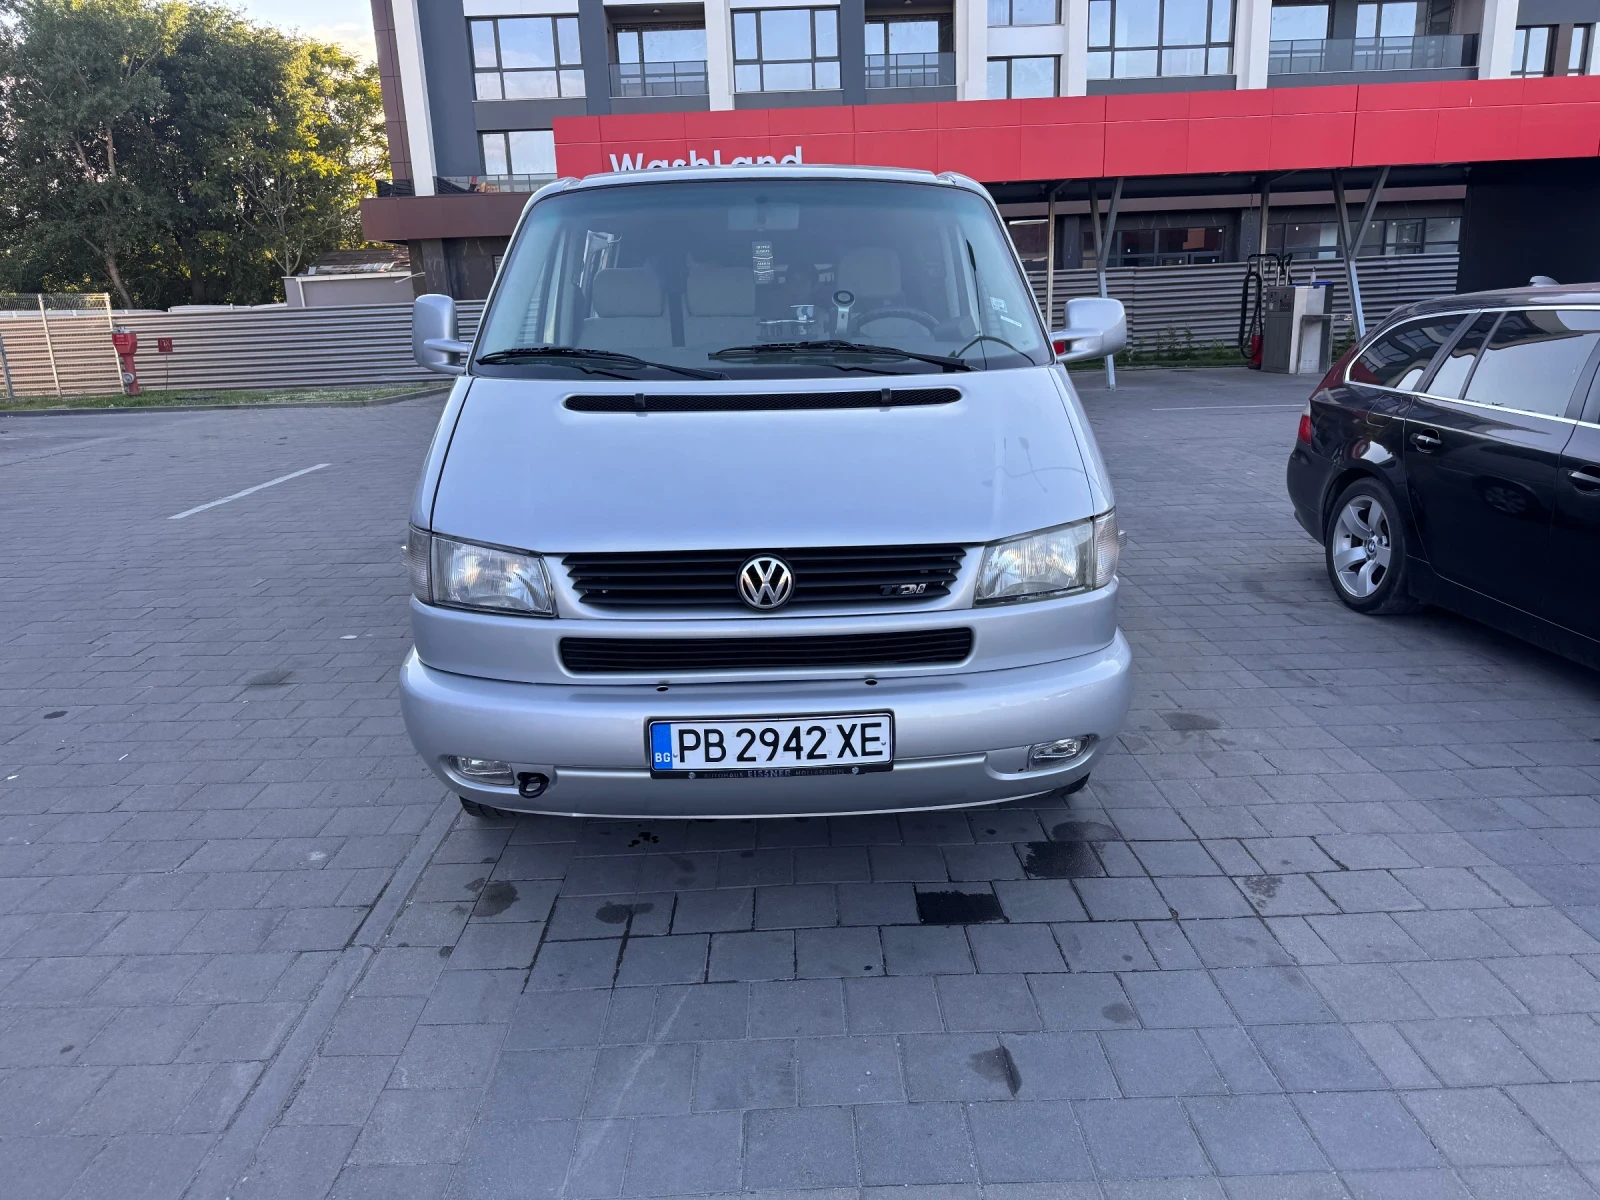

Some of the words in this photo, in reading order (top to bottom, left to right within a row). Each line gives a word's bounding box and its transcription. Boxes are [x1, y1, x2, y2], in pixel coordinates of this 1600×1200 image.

[678, 729, 727, 763] PB
[735, 725, 828, 762] 2942
[836, 722, 883, 759] XE
[655, 752, 671, 763] BG
[747, 769, 791, 778] EISSNER
